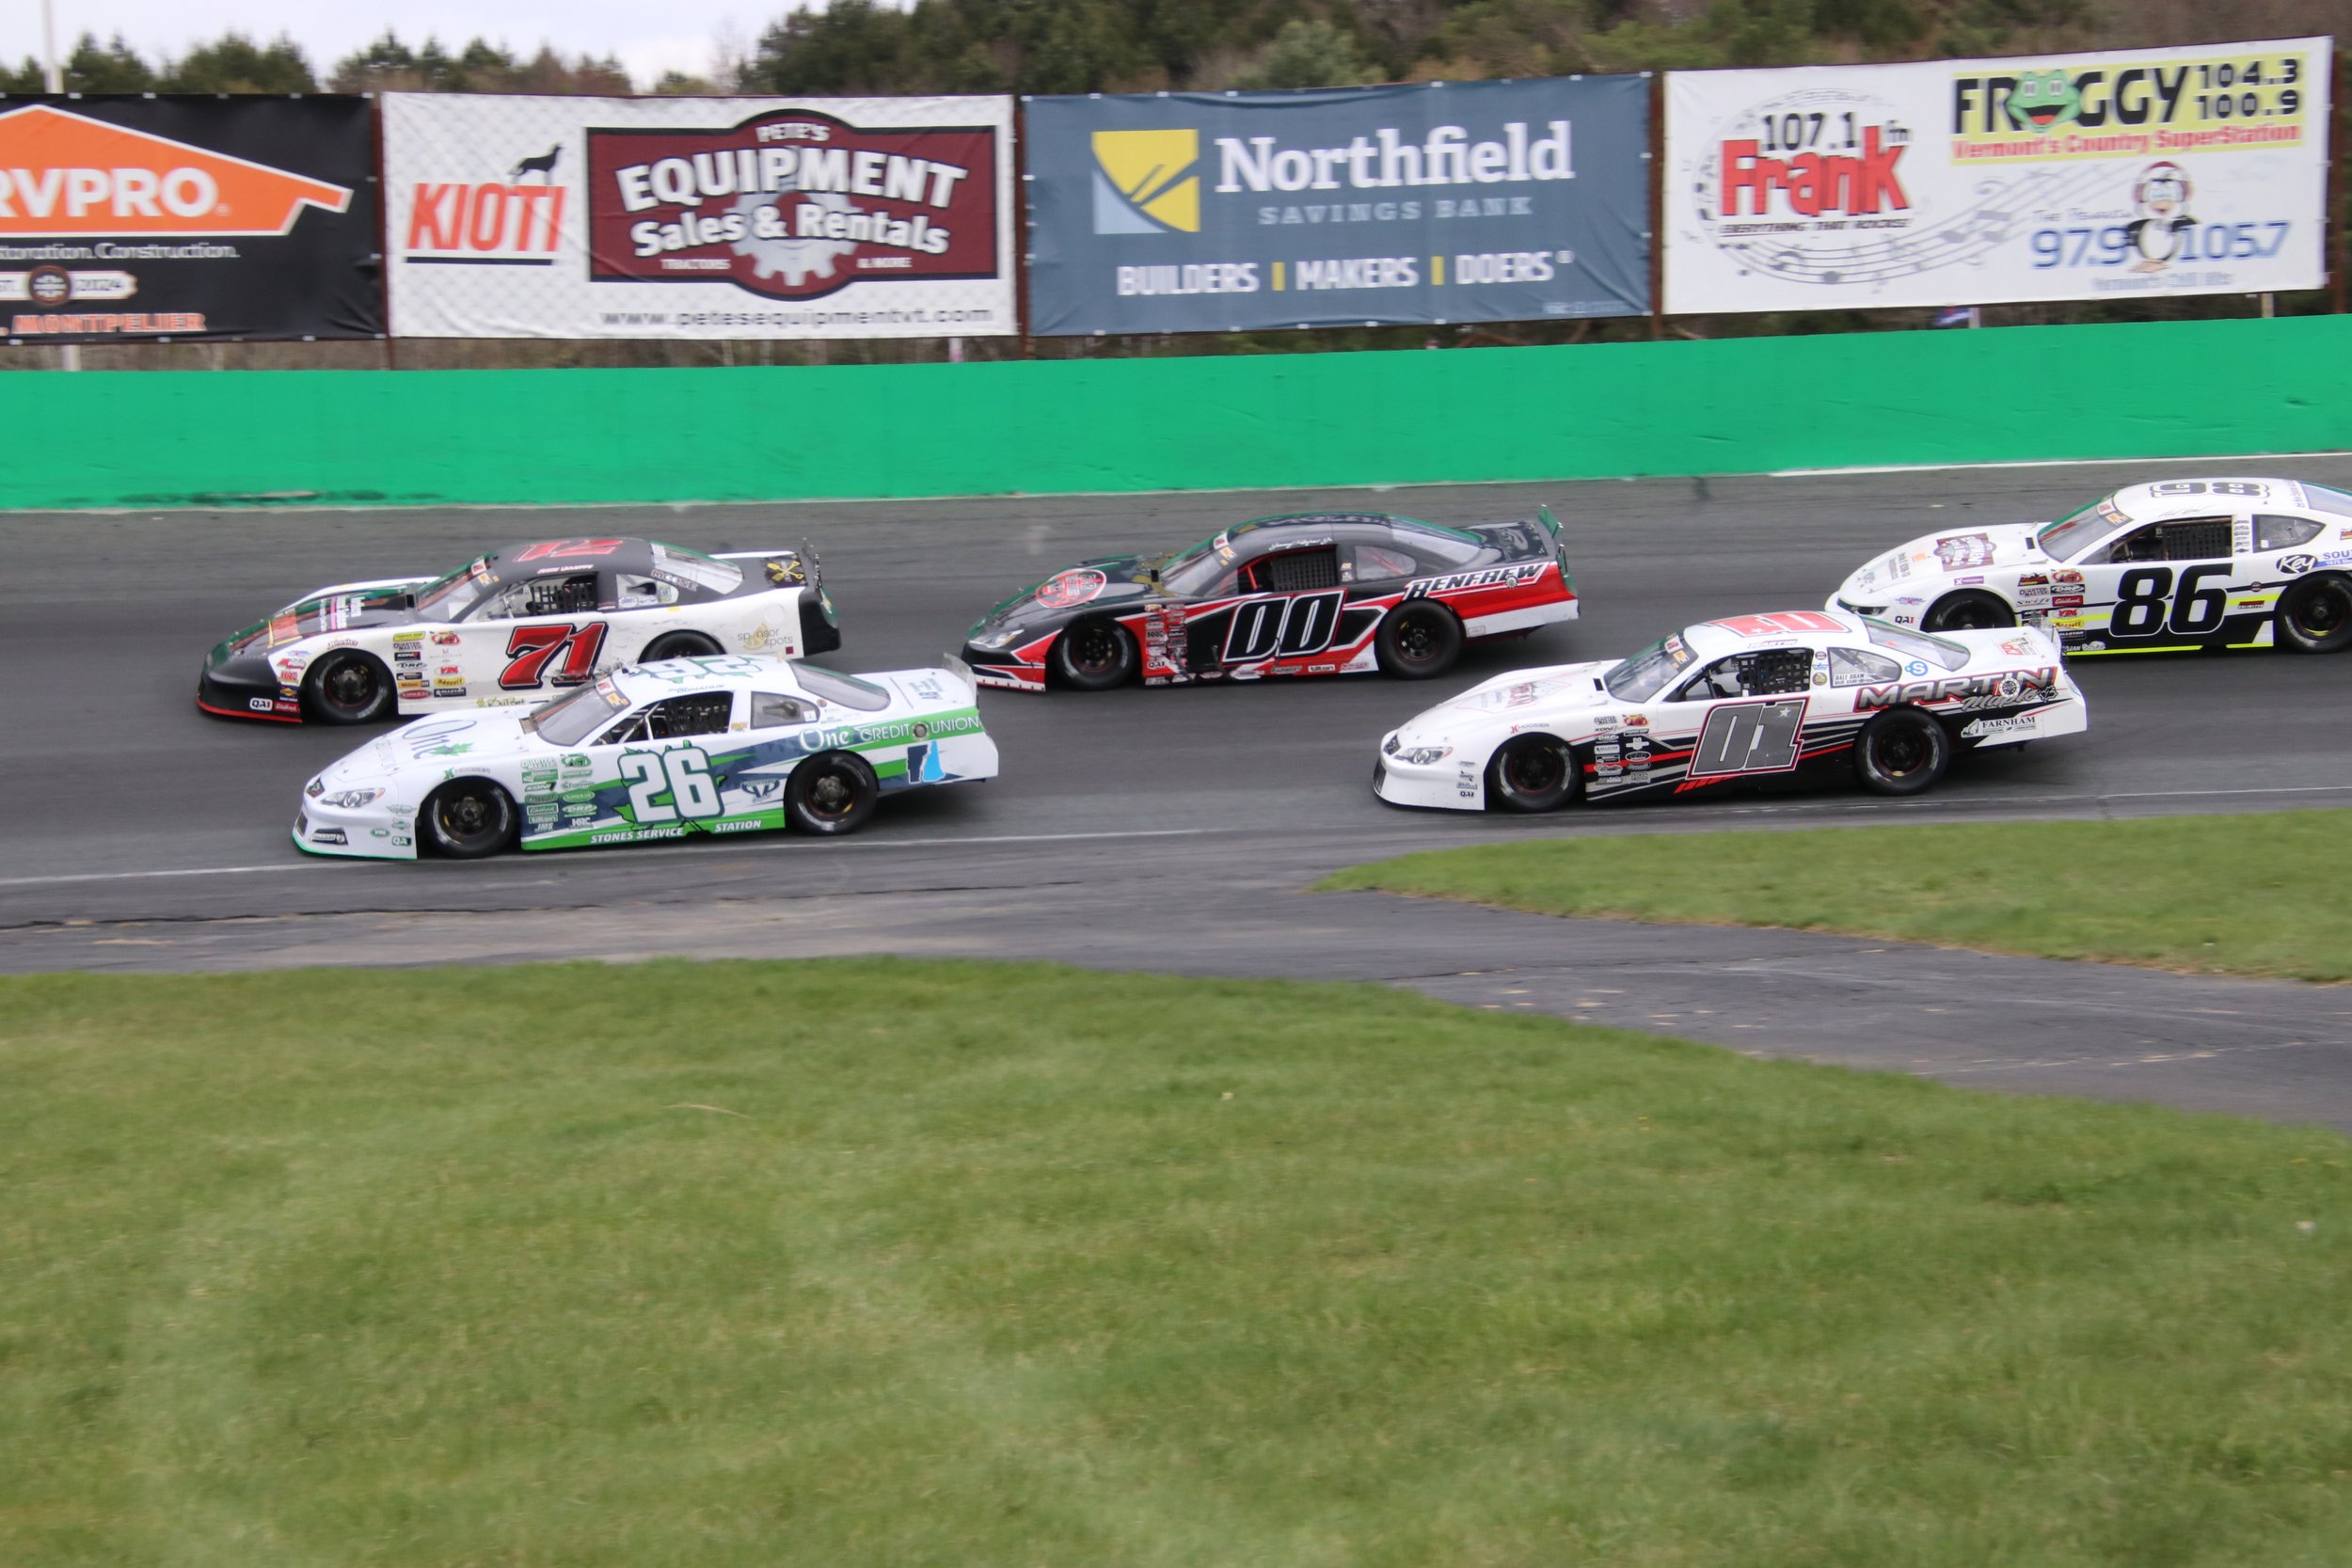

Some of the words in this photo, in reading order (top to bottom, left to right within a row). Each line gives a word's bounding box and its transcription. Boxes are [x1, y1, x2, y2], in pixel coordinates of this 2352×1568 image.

[755, 122, 832, 142] PETE'S
[1761, 111, 1855, 150] 107.1
[1952, 137, 2060, 159] Vermont's
[2065, 134, 2152, 154] Country
[1214, 119, 1577, 194] Northfield
[1719, 125, 1911, 217] Frank
[615, 147, 969, 213] EQUIPMENT
[406, 182, 567, 252] KIOTI
[630, 211, 749, 257] Sales
[754, 205, 793, 239] &
[795, 202, 951, 254] Rentals
[1258, 201, 1422, 226] SAVINGS
[1435, 196, 1534, 220] BANK
[1116, 263, 1259, 296] BUILDERS
[1295, 257, 1419, 292] MAKERS
[10, 312, 208, 335] MONTPELIER
[2323, 550, 2352, 561] SOU
[1405, 564, 1544, 600] RENFREW
[2109, 562, 2235, 638] 86
[1222, 591, 1346, 664] 00
[1895, 615, 1915, 625] QA1
[498, 620, 610, 691] 71
[765, 636, 794, 648] spots
[251, 699, 272, 709] QA1
[1961, 688, 2040, 712] Maple
[799, 728, 851, 752] One
[860, 721, 911, 743] CREDIT
[930, 715, 983, 735] UNION
[1687, 698, 1808, 780] 01
[1982, 717, 2036, 729] FARNHAM
[616, 744, 724, 825] 26
[591, 830, 633, 844] STONES
[636, 827, 685, 840] SERVICE
[714, 819, 762, 833] STATION
